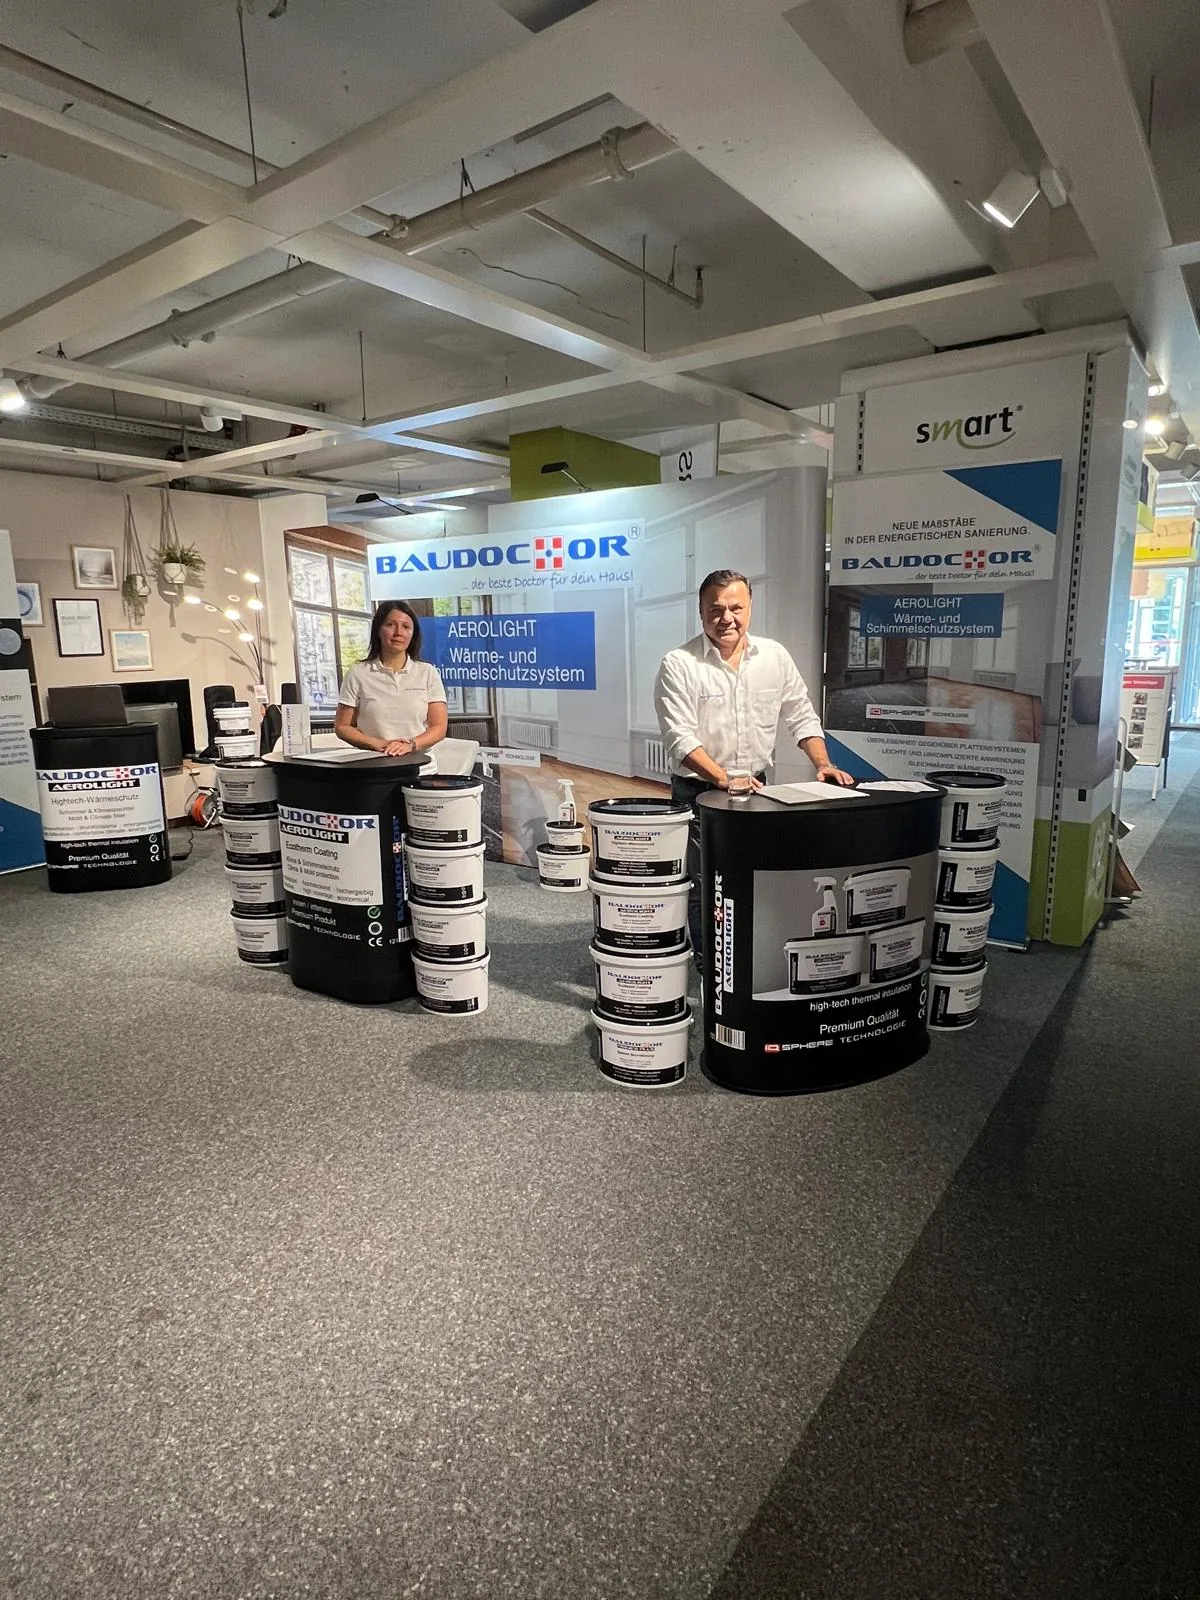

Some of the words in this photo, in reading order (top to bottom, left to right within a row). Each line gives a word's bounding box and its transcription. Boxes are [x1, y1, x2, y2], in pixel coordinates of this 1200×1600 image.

[916, 406, 1015, 448] smart
[892, 520, 919, 531] NEUE
[845, 536, 854, 544] IN
[856, 535, 876, 544] DER
[878, 530, 961, 543] ENERGETISCHEN
[964, 526, 1031, 538] SANIERUNG.
[471, 577, 486, 590] der
[488, 576, 512, 589] beste
[514, 574, 546, 587] Doctor
[549, 573, 569, 589] für
[571, 571, 594, 584] dein
[599, 570, 634, 582] Haus!
[915, 572, 927, 580] der
[929, 571, 947, 580] beste
[948, 570, 972, 580] Doctor
[974, 570, 987, 580] für
[989, 570, 1007, 579] dein
[894, 598, 963, 609] AEROLIGHT
[894, 613, 936, 624] Wärme-
[939, 613, 961, 624] und
[448, 619, 537, 638] AEROLIGHT
[866, 623, 994, 635] Schimmelschutzsystem
[449, 647, 505, 664] Wärme-
[509, 647, 537, 663] und
[959, 743, 1027, 754] PLATTENSYSTEMEN
[981, 756, 1025, 766] ANWENDUNG
[52, 780, 136, 791] AEROLIGHT
[281, 824, 344, 842] AEROLIGHT
[101, 852, 129, 861] Qualität
[314, 846, 338, 860] Coating
[83, 860, 138, 868] TECHNOLOGIE
[314, 913, 337, 926] Produkt
[313, 926, 361, 941] TECHNOLOGIE
[725, 903, 734, 987] AEROLIGHT
[810, 999, 850, 1012] high-tech
[852, 992, 881, 1005] thermal
[882, 983, 912, 999] insulation
[820, 1020, 865, 1035] Premium
[867, 1009, 900, 1026] Qualität
[782, 1040, 834, 1051] SPHERE
[840, 1020, 907, 1043] TECHNOLOGIE
